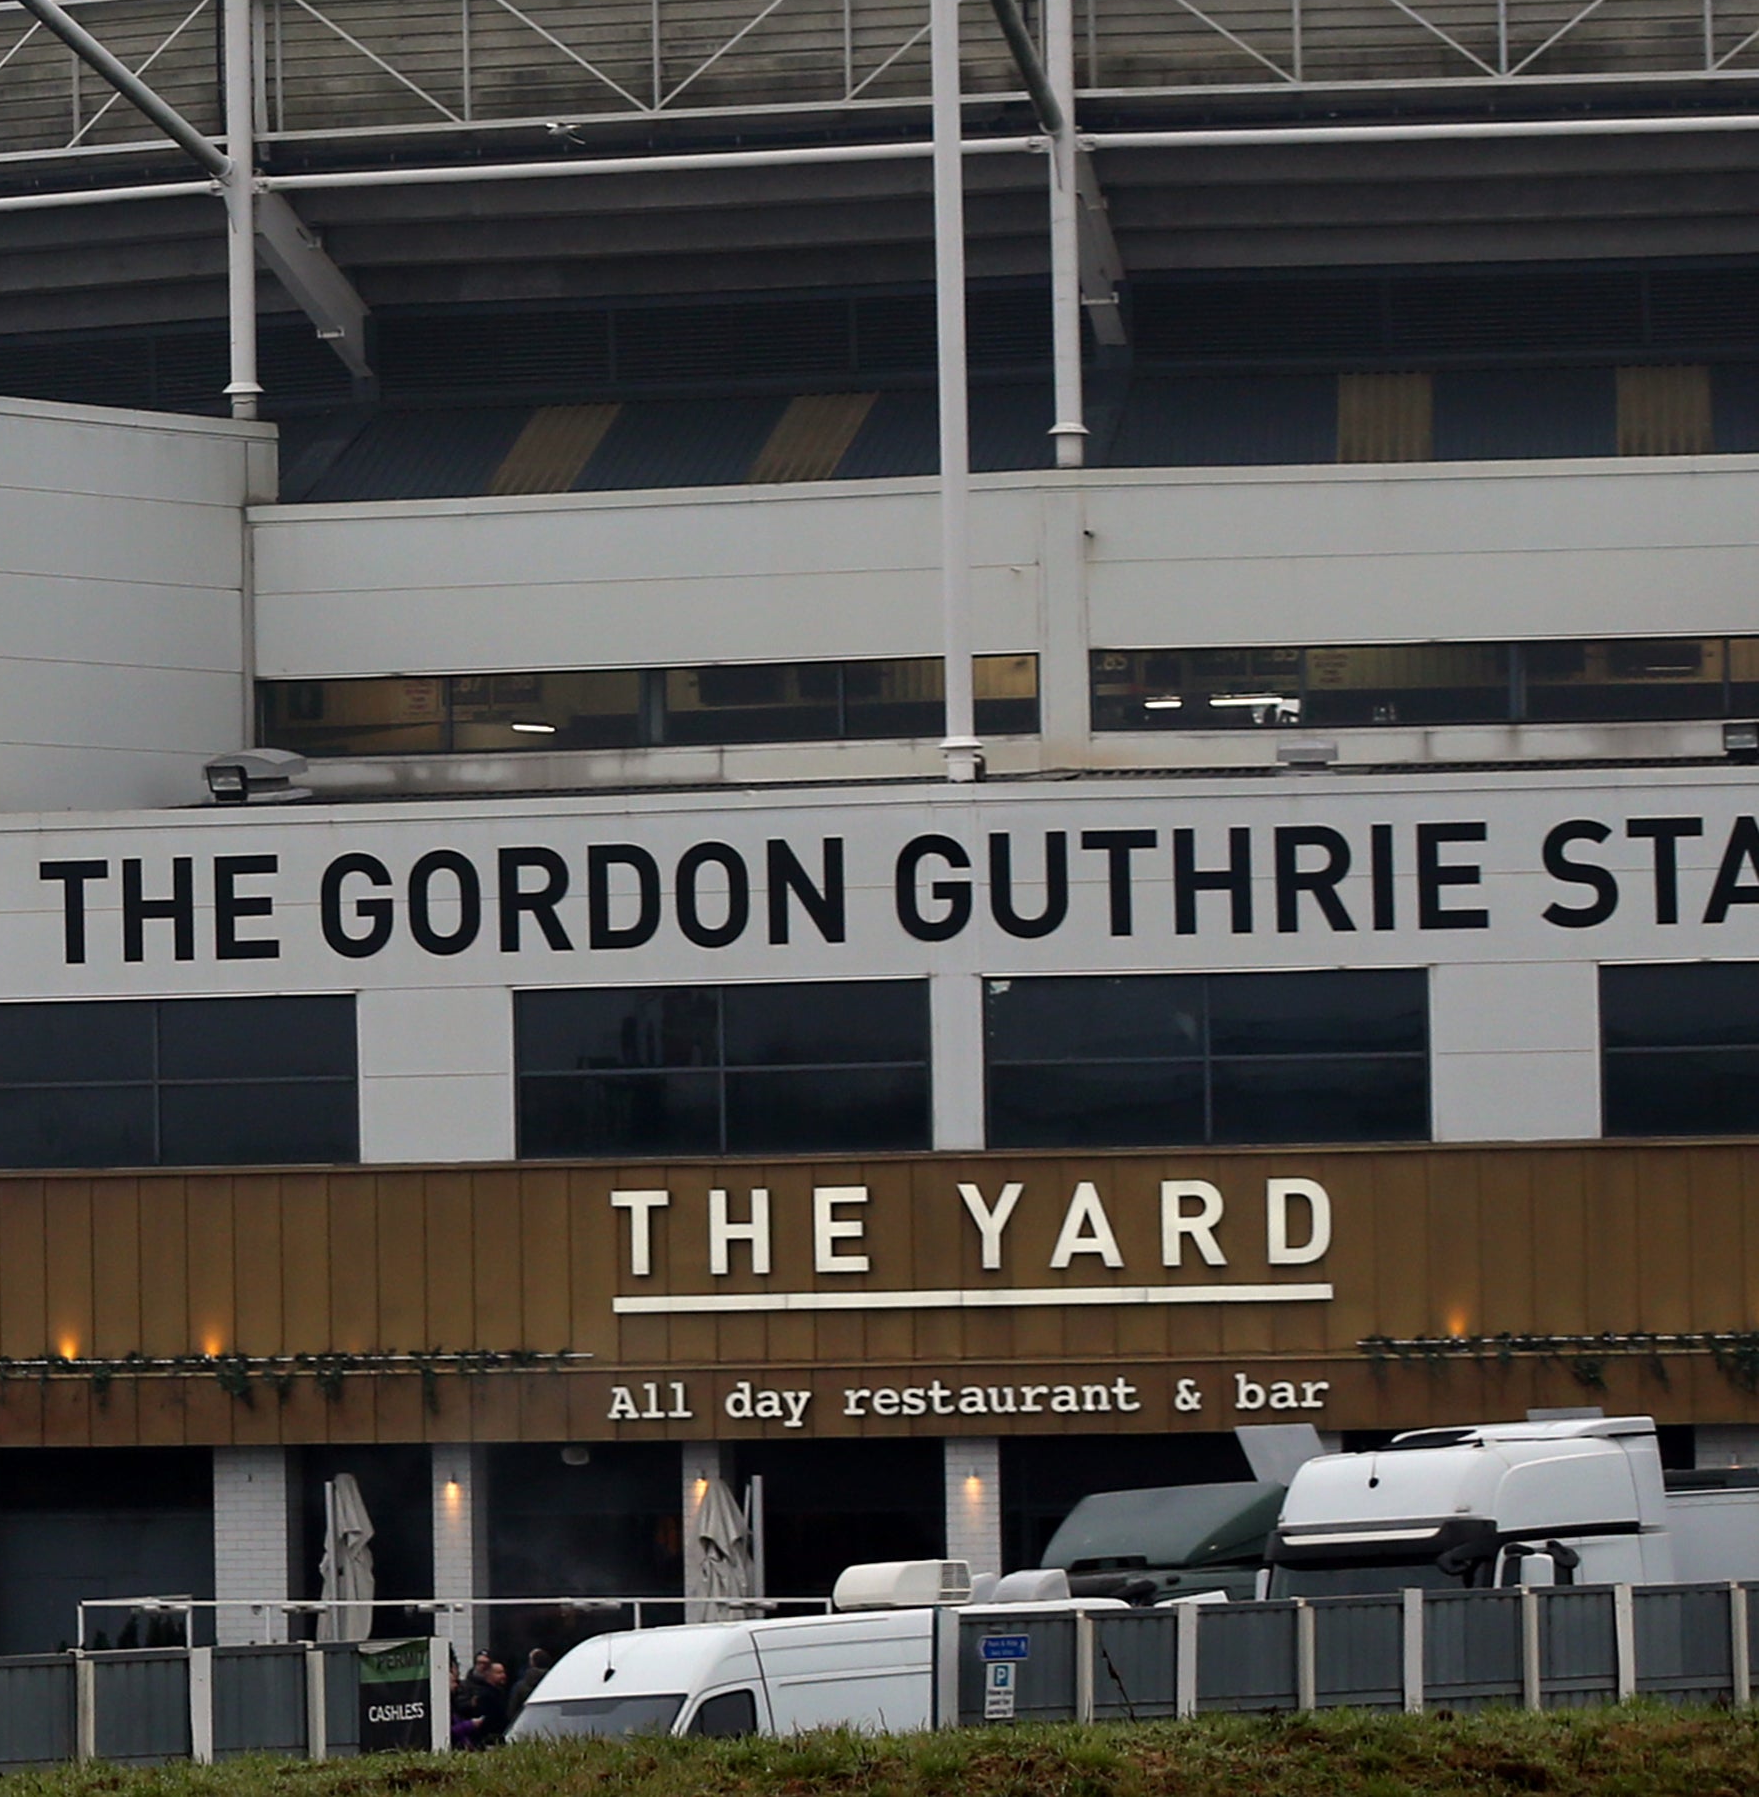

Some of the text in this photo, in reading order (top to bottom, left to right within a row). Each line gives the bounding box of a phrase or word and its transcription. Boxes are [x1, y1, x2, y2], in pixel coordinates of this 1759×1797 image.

[39, 816, 1759, 965] THE GORDON GUTHRIE STA
[611, 1178, 1333, 1277] THE YARD
[607, 1373, 1331, 1429] All day restaurant & bar
[996, 1667, 1006, 1685] P
[368, 1702, 425, 1723] CASHLESS
